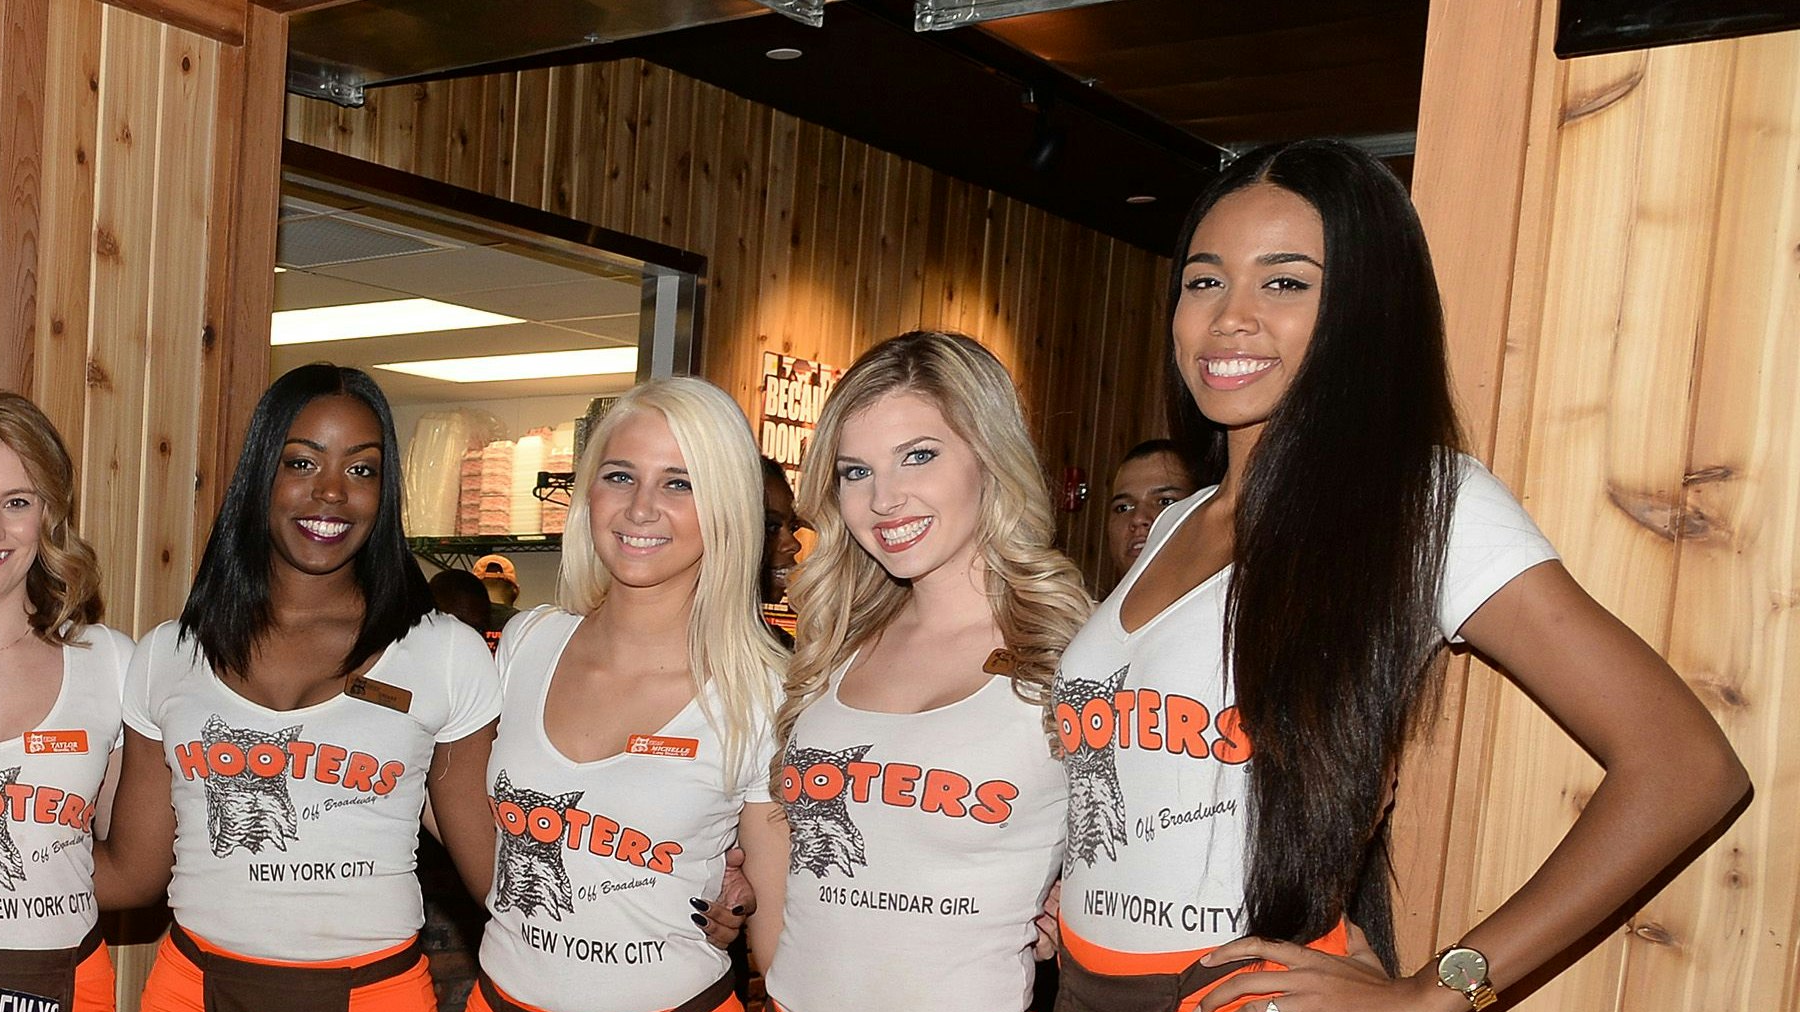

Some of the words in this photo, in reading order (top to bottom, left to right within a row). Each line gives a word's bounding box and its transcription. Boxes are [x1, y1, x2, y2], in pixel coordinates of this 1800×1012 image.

[1056, 688, 1254, 765] OOTERS
[174, 741, 405, 796] HOOTERS
[302, 805, 320, 821] Off
[324, 795, 377, 813] Broadway
[1135, 814, 1156, 842] Off
[1159, 797, 1238, 831] Broadway
[32, 846, 49, 863] Off
[249, 863, 285, 882] NEW
[290, 862, 336, 881] YORK
[341, 860, 375, 878] CITY
[577, 885, 598, 902] Off
[601, 876, 657, 895] Broadway
[819, 885, 847, 906] 2015
[850, 889, 934, 915] CALENDAR
[939, 897, 980, 916] GIRL
[23, 895, 65, 918] YORK
[68, 892, 92, 914] CITY
[1084, 889, 1120, 918] NEW
[1120, 893, 1174, 929] YORK
[1181, 904, 1244, 933] CITY
[521, 922, 557, 954] NEW
[563, 935, 618, 965] YORK
[625, 940, 666, 964] CITY
